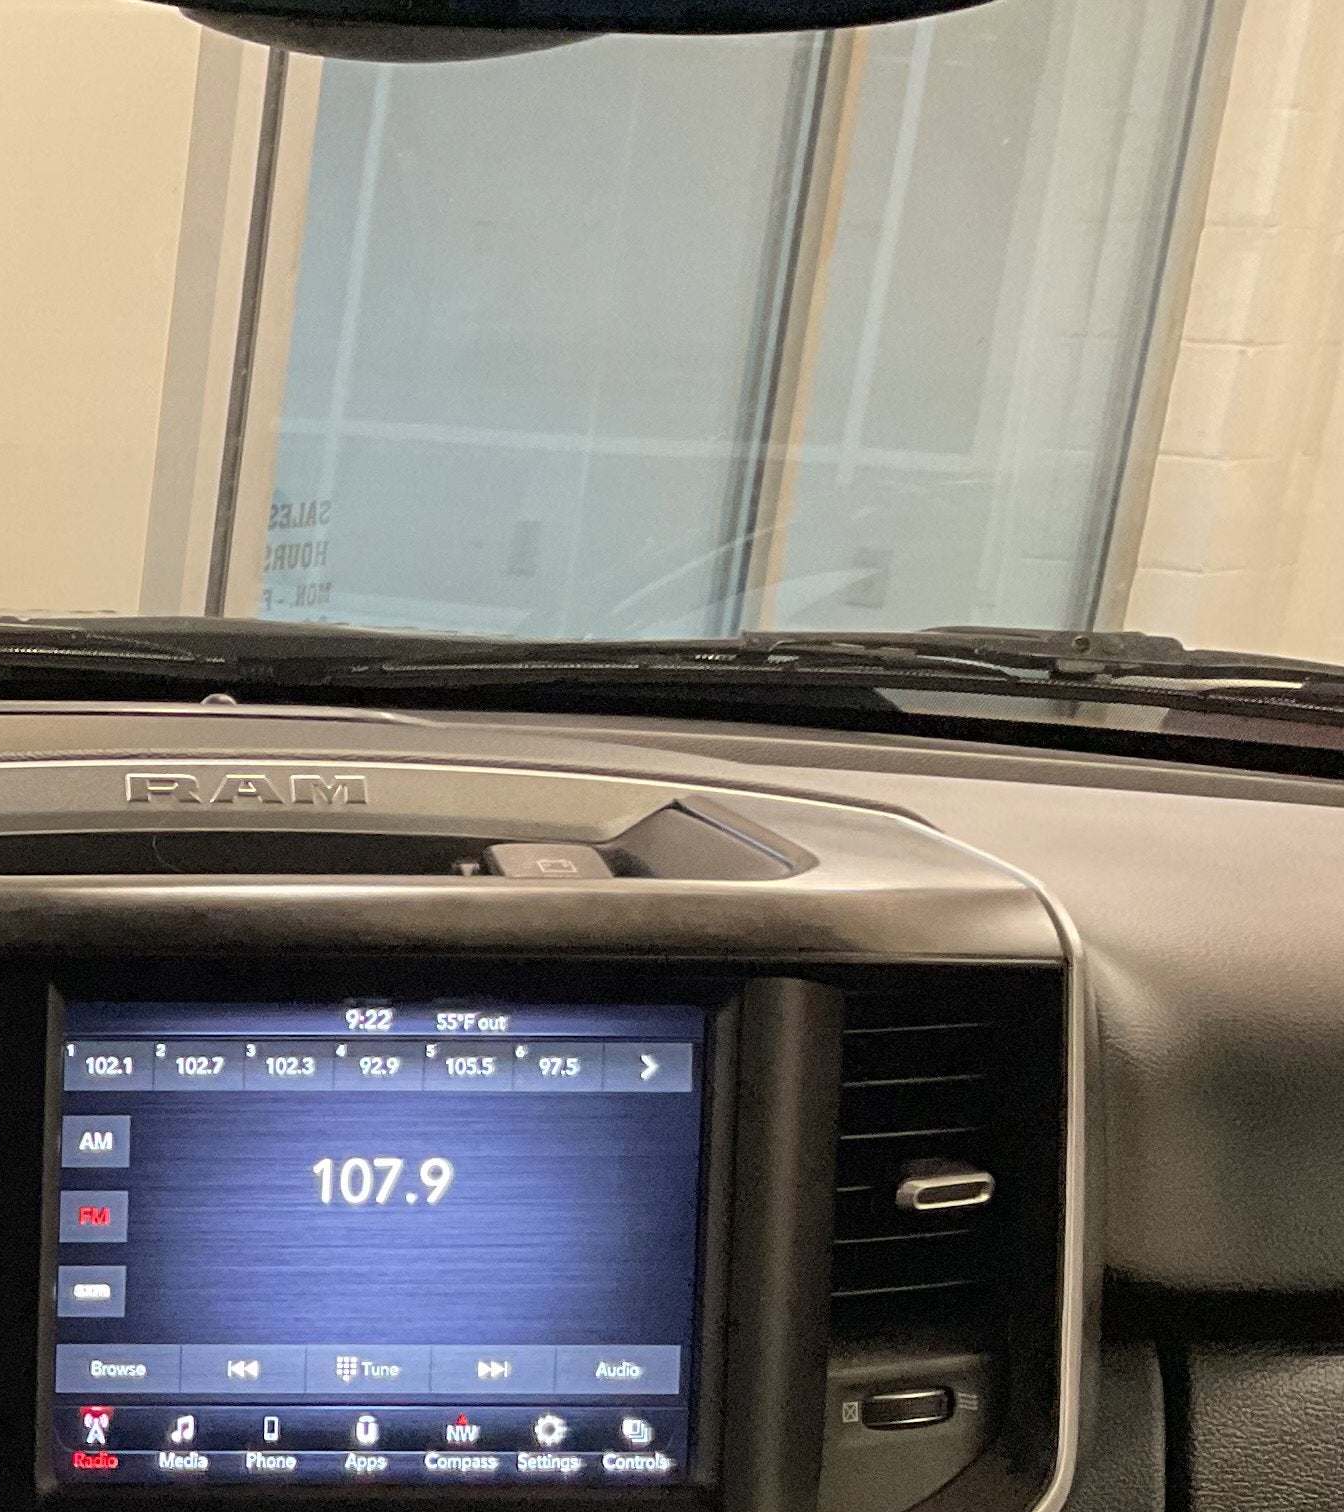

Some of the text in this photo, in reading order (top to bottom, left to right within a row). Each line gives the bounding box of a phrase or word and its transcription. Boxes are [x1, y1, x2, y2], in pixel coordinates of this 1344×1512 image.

[124, 773, 369, 804] RAM
[345, 1009, 507, 1031] 9:22 55°F out
[66, 1043, 133, 1075] 1 102.1
[155, 1043, 224, 1075] 2 102.7
[245, 1043, 314, 1075] 3 102.3
[335, 1043, 400, 1075] 4 92.9
[425, 1044, 494, 1075] 5 105.5
[515, 1045, 579, 1076] 6 97.5
[78, 1131, 113, 1151] AM
[312, 1156, 454, 1206] 107.9
[78, 1206, 111, 1226] FM
[90, 1360, 641, 1378] Browse Tune Audio
[446, 1425, 479, 1443] NW
[72, 1451, 669, 1473] Radio Media Phone Apps Compass Settings Controls
